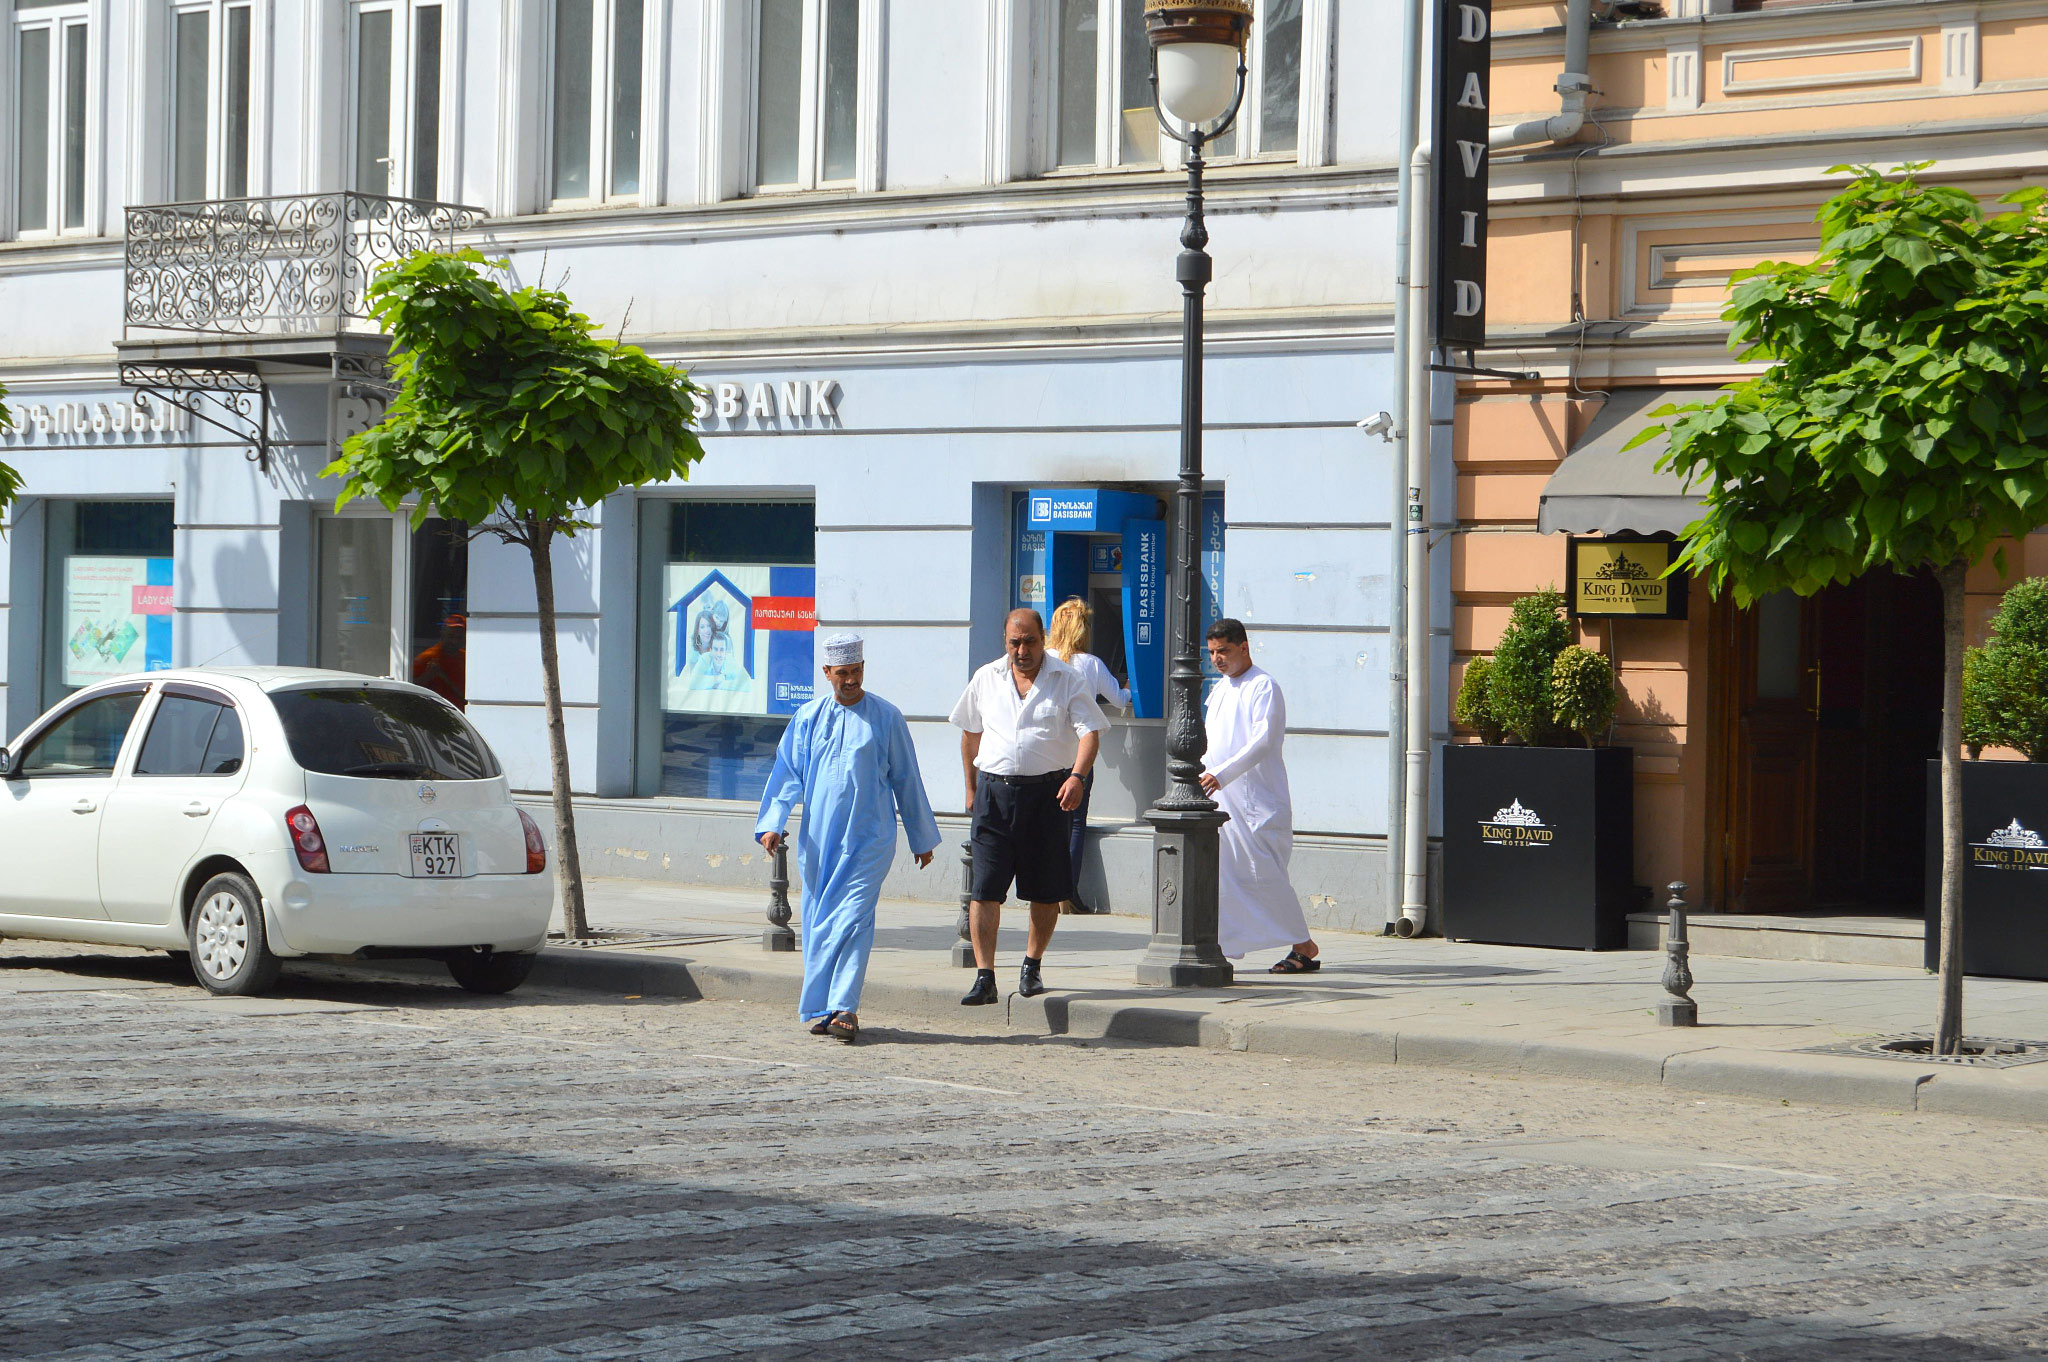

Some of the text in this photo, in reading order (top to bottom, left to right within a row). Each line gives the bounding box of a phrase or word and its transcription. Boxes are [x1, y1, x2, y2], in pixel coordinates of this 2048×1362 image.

[1456, 4, 1488, 318] DAVID
[1053, 510, 1093, 519] BASISBANK
[1140, 532, 1149, 617] BASISBANK
[1583, 582, 1663, 596] KING DAVID
[137, 595, 159, 605] LADY
[1481, 825, 1553, 841] KING DAVID
[413, 845, 422, 854] GE
[423, 837, 455, 855] KTK
[1973, 847, 2008, 863] KING
[425, 857, 456, 875] 927
